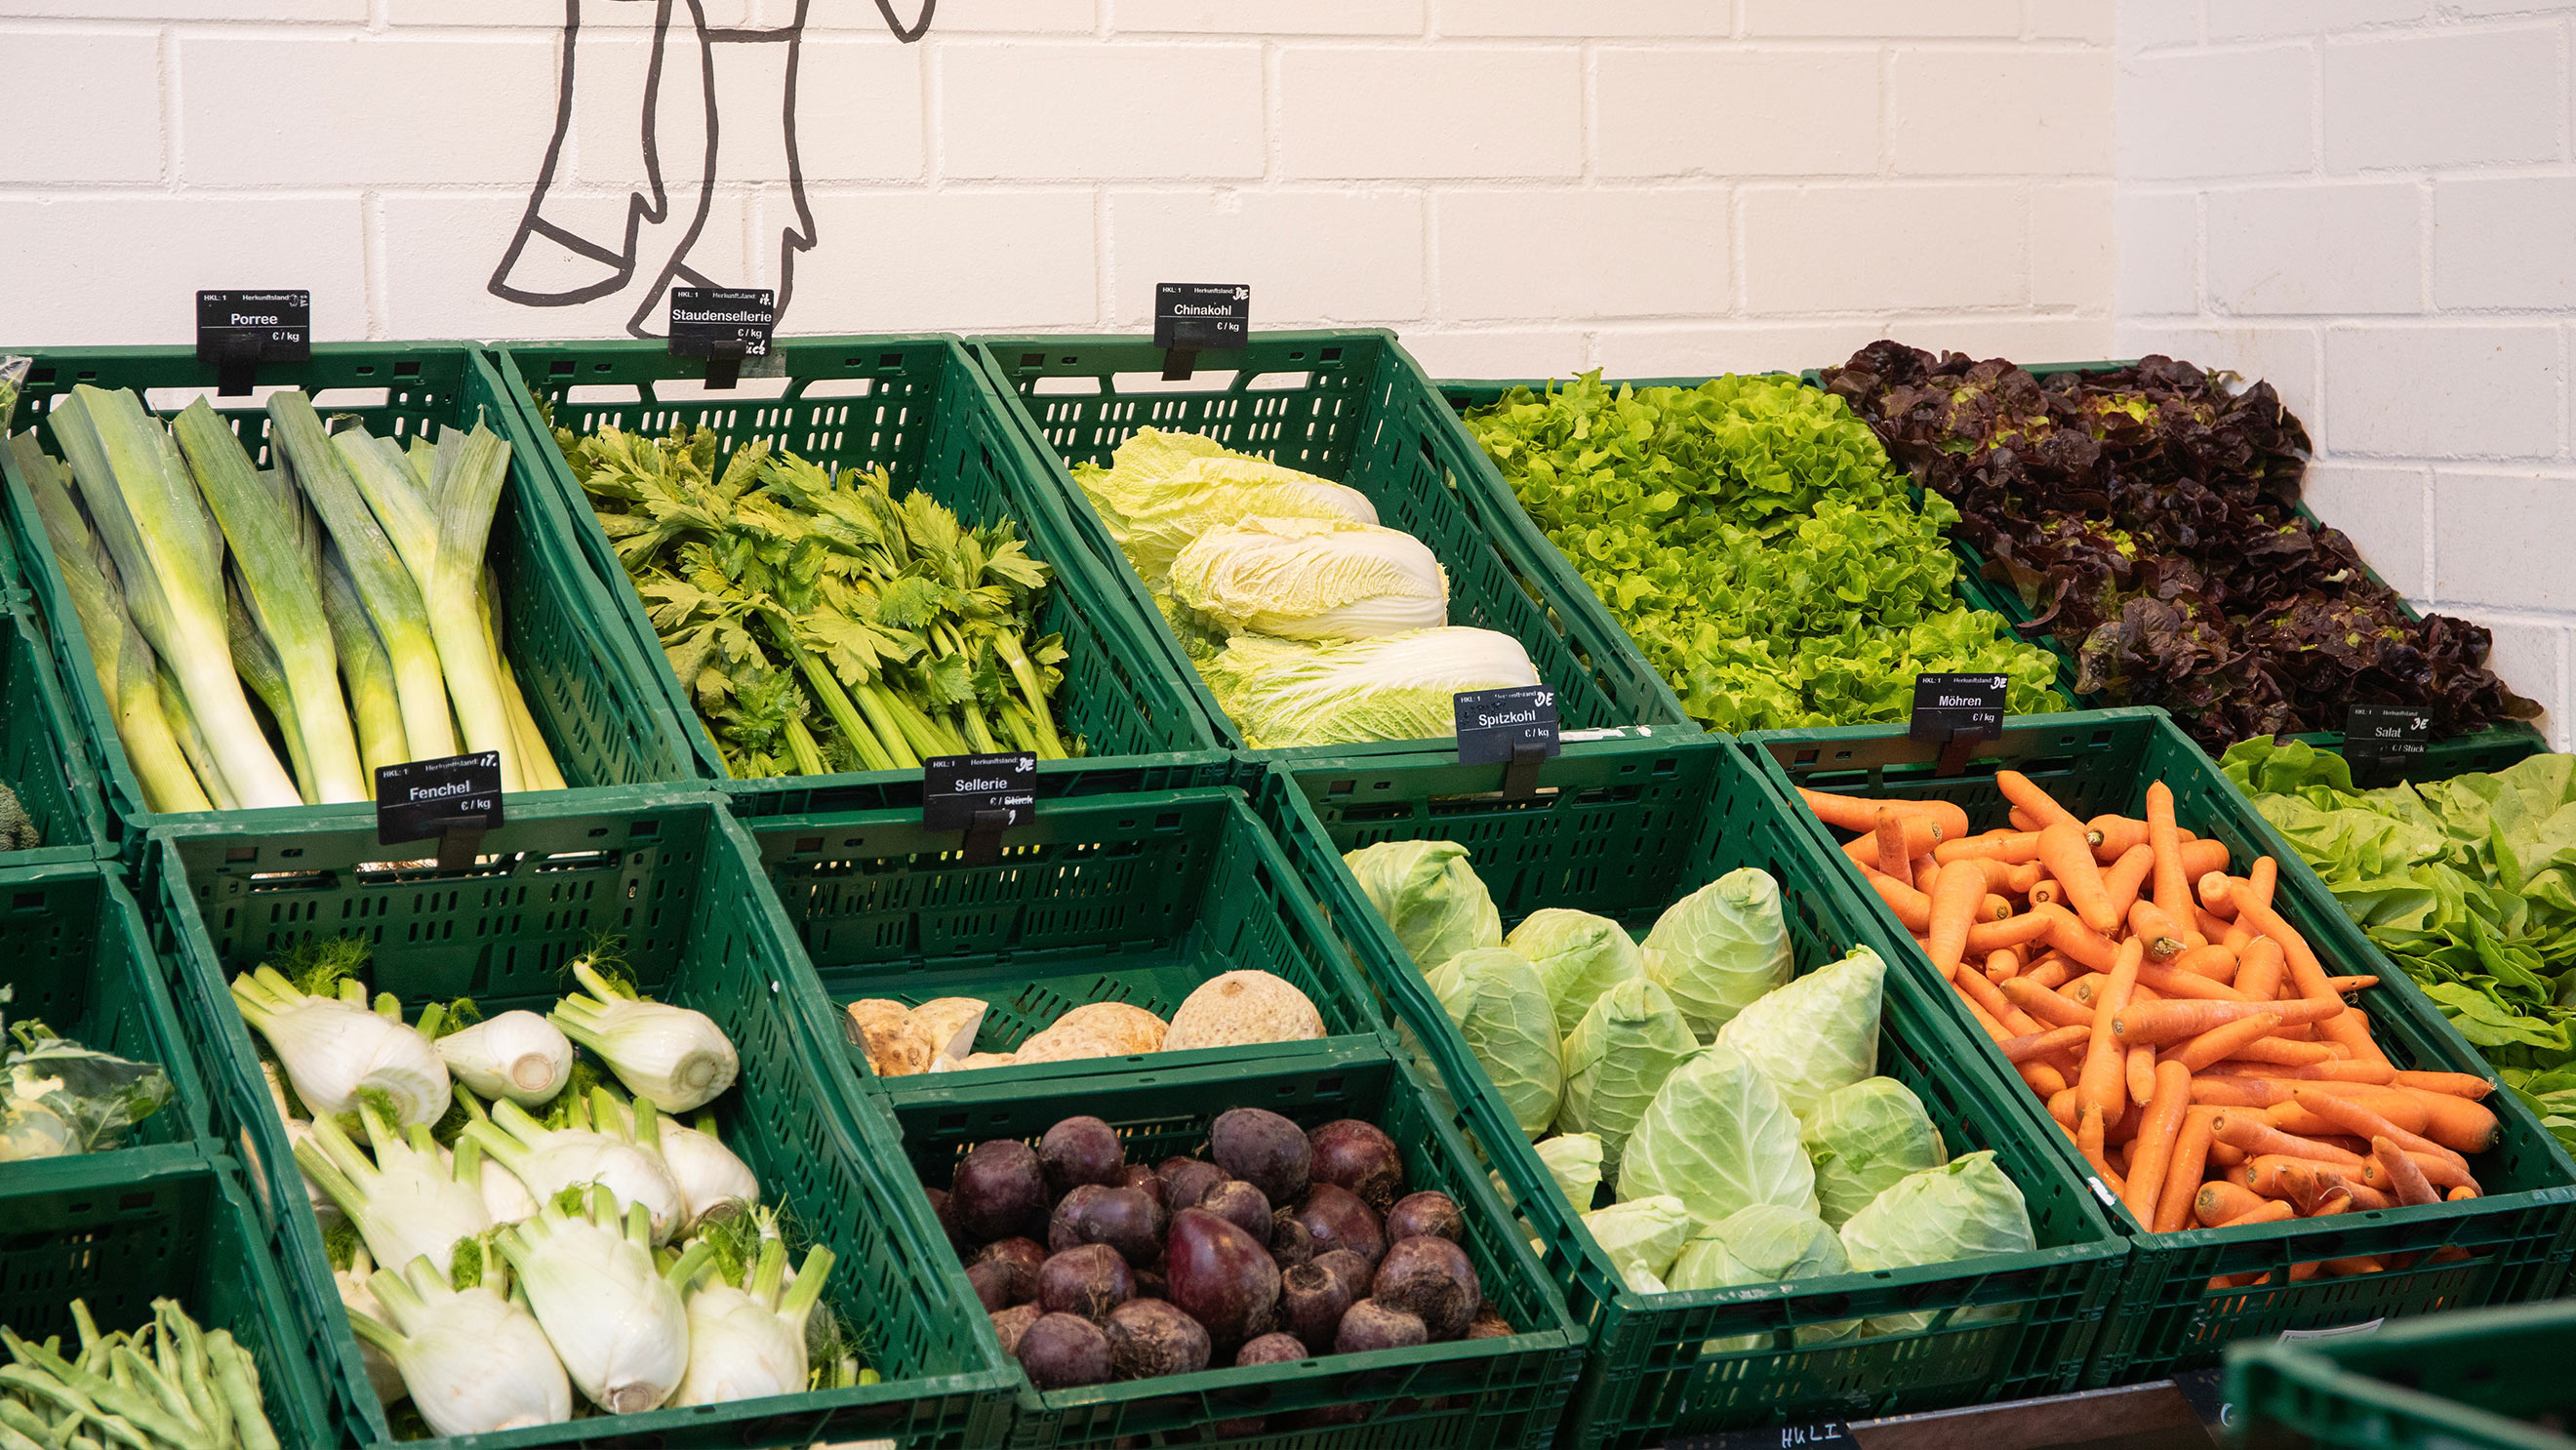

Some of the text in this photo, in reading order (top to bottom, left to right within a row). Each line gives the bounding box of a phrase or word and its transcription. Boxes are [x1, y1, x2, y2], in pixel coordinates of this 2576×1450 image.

[1232, 287, 1249, 301] DE
[671, 308, 773, 322] Staudensellerie
[1174, 304, 1232, 316] Chinakohl
[230, 313, 278, 325] Porree
[1991, 676, 2008, 690] DE
[1534, 691, 1554, 707] DE
[1939, 695, 1982, 706] Möhren
[1478, 709, 1536, 728] Spitzkohl
[2375, 726, 2401, 738] Salat
[1015, 756, 1034, 773] DE
[409, 780, 470, 800] Fenchel
[954, 778, 1008, 791] Sellerie
